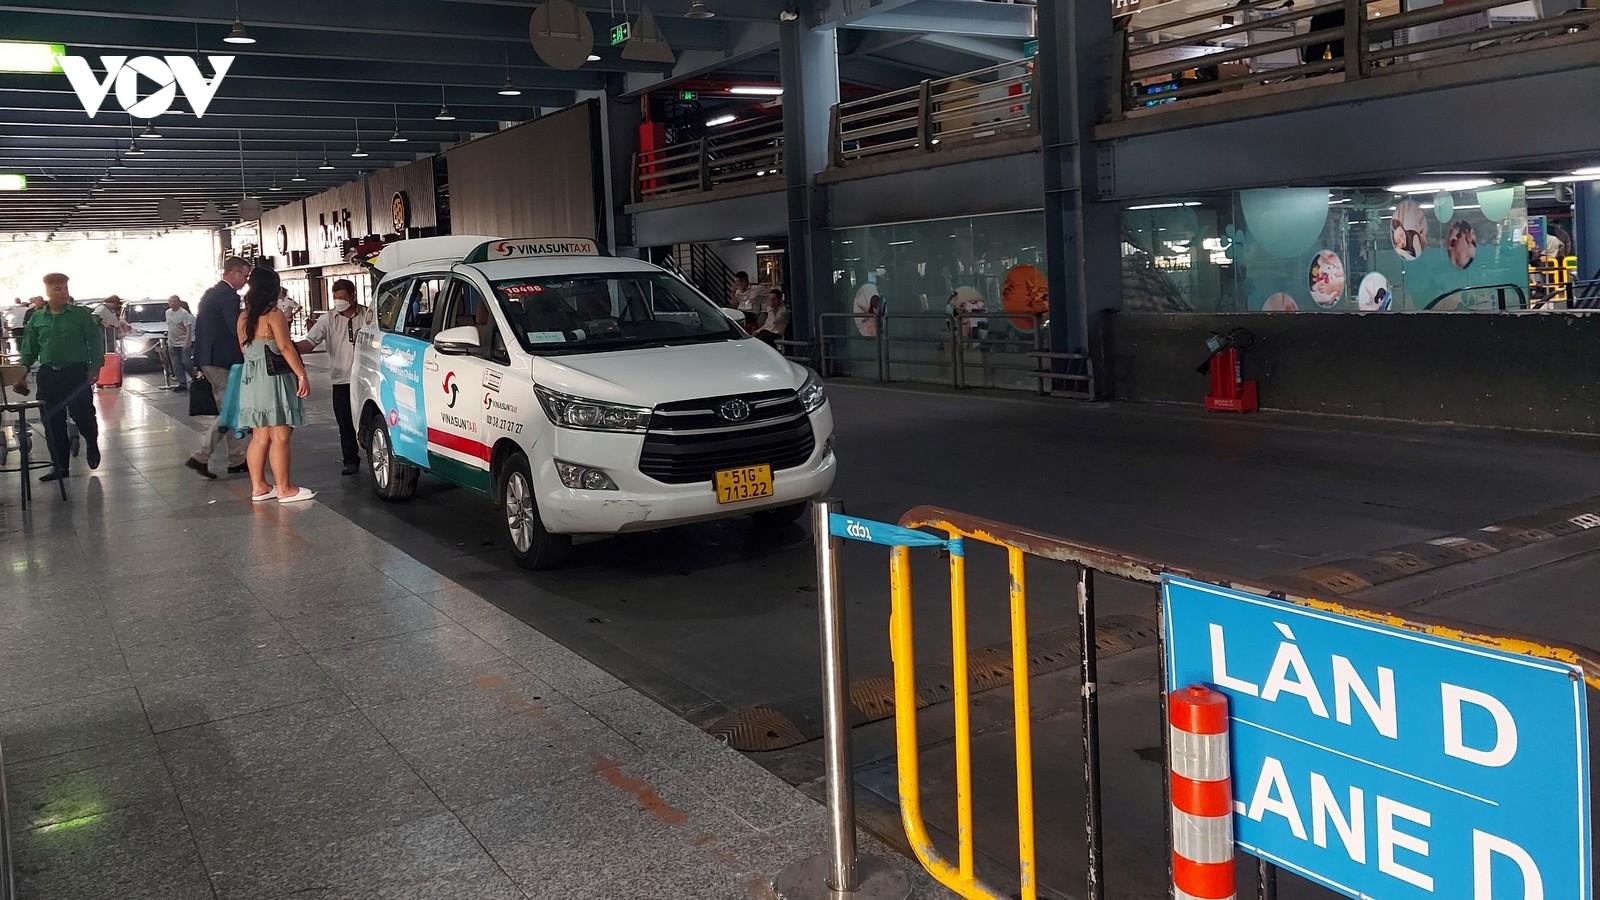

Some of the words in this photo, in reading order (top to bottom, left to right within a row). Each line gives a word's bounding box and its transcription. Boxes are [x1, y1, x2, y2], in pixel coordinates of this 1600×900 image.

[517, 243, 591, 255] VINASUNTAXI
[493, 400, 518, 413] VINASUNTAXI
[441, 411, 478, 434] VINASUNTAXI
[731, 468, 756, 484] 51G
[724, 482, 768, 501] 713.22
[1207, 622, 1399, 740] LÀN
[1439, 682, 1519, 768] D
[1233, 755, 1434, 892] ANE
[1471, 828, 1544, 900] D
